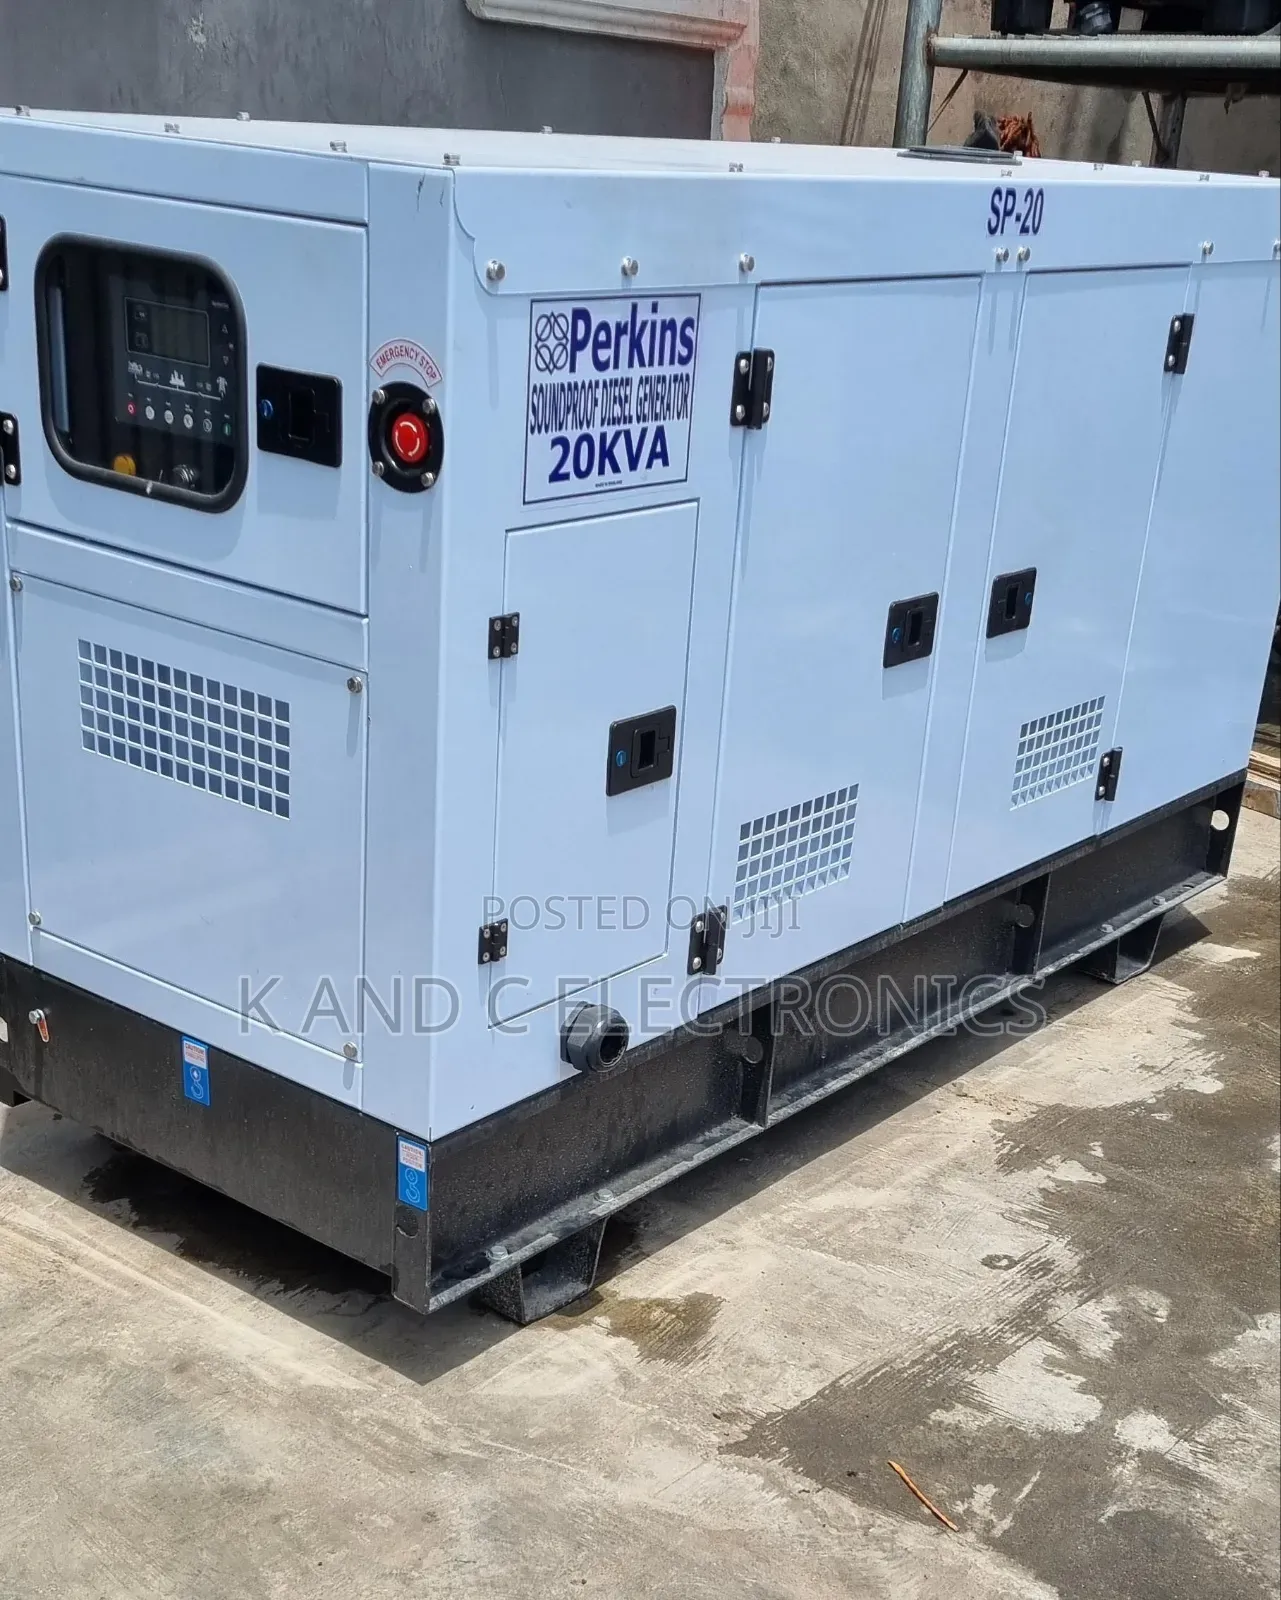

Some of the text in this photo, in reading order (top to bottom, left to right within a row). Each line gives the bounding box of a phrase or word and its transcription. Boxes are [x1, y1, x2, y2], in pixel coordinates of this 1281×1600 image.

[987, 186, 1044, 236] SP-20
[375, 345, 437, 379] EMERGENCY STOP
[569, 301, 696, 373] Perkins
[530, 372, 691, 435] SOUNDPROOF DIESEL GENERATOR
[548, 424, 670, 484] 20KVA
